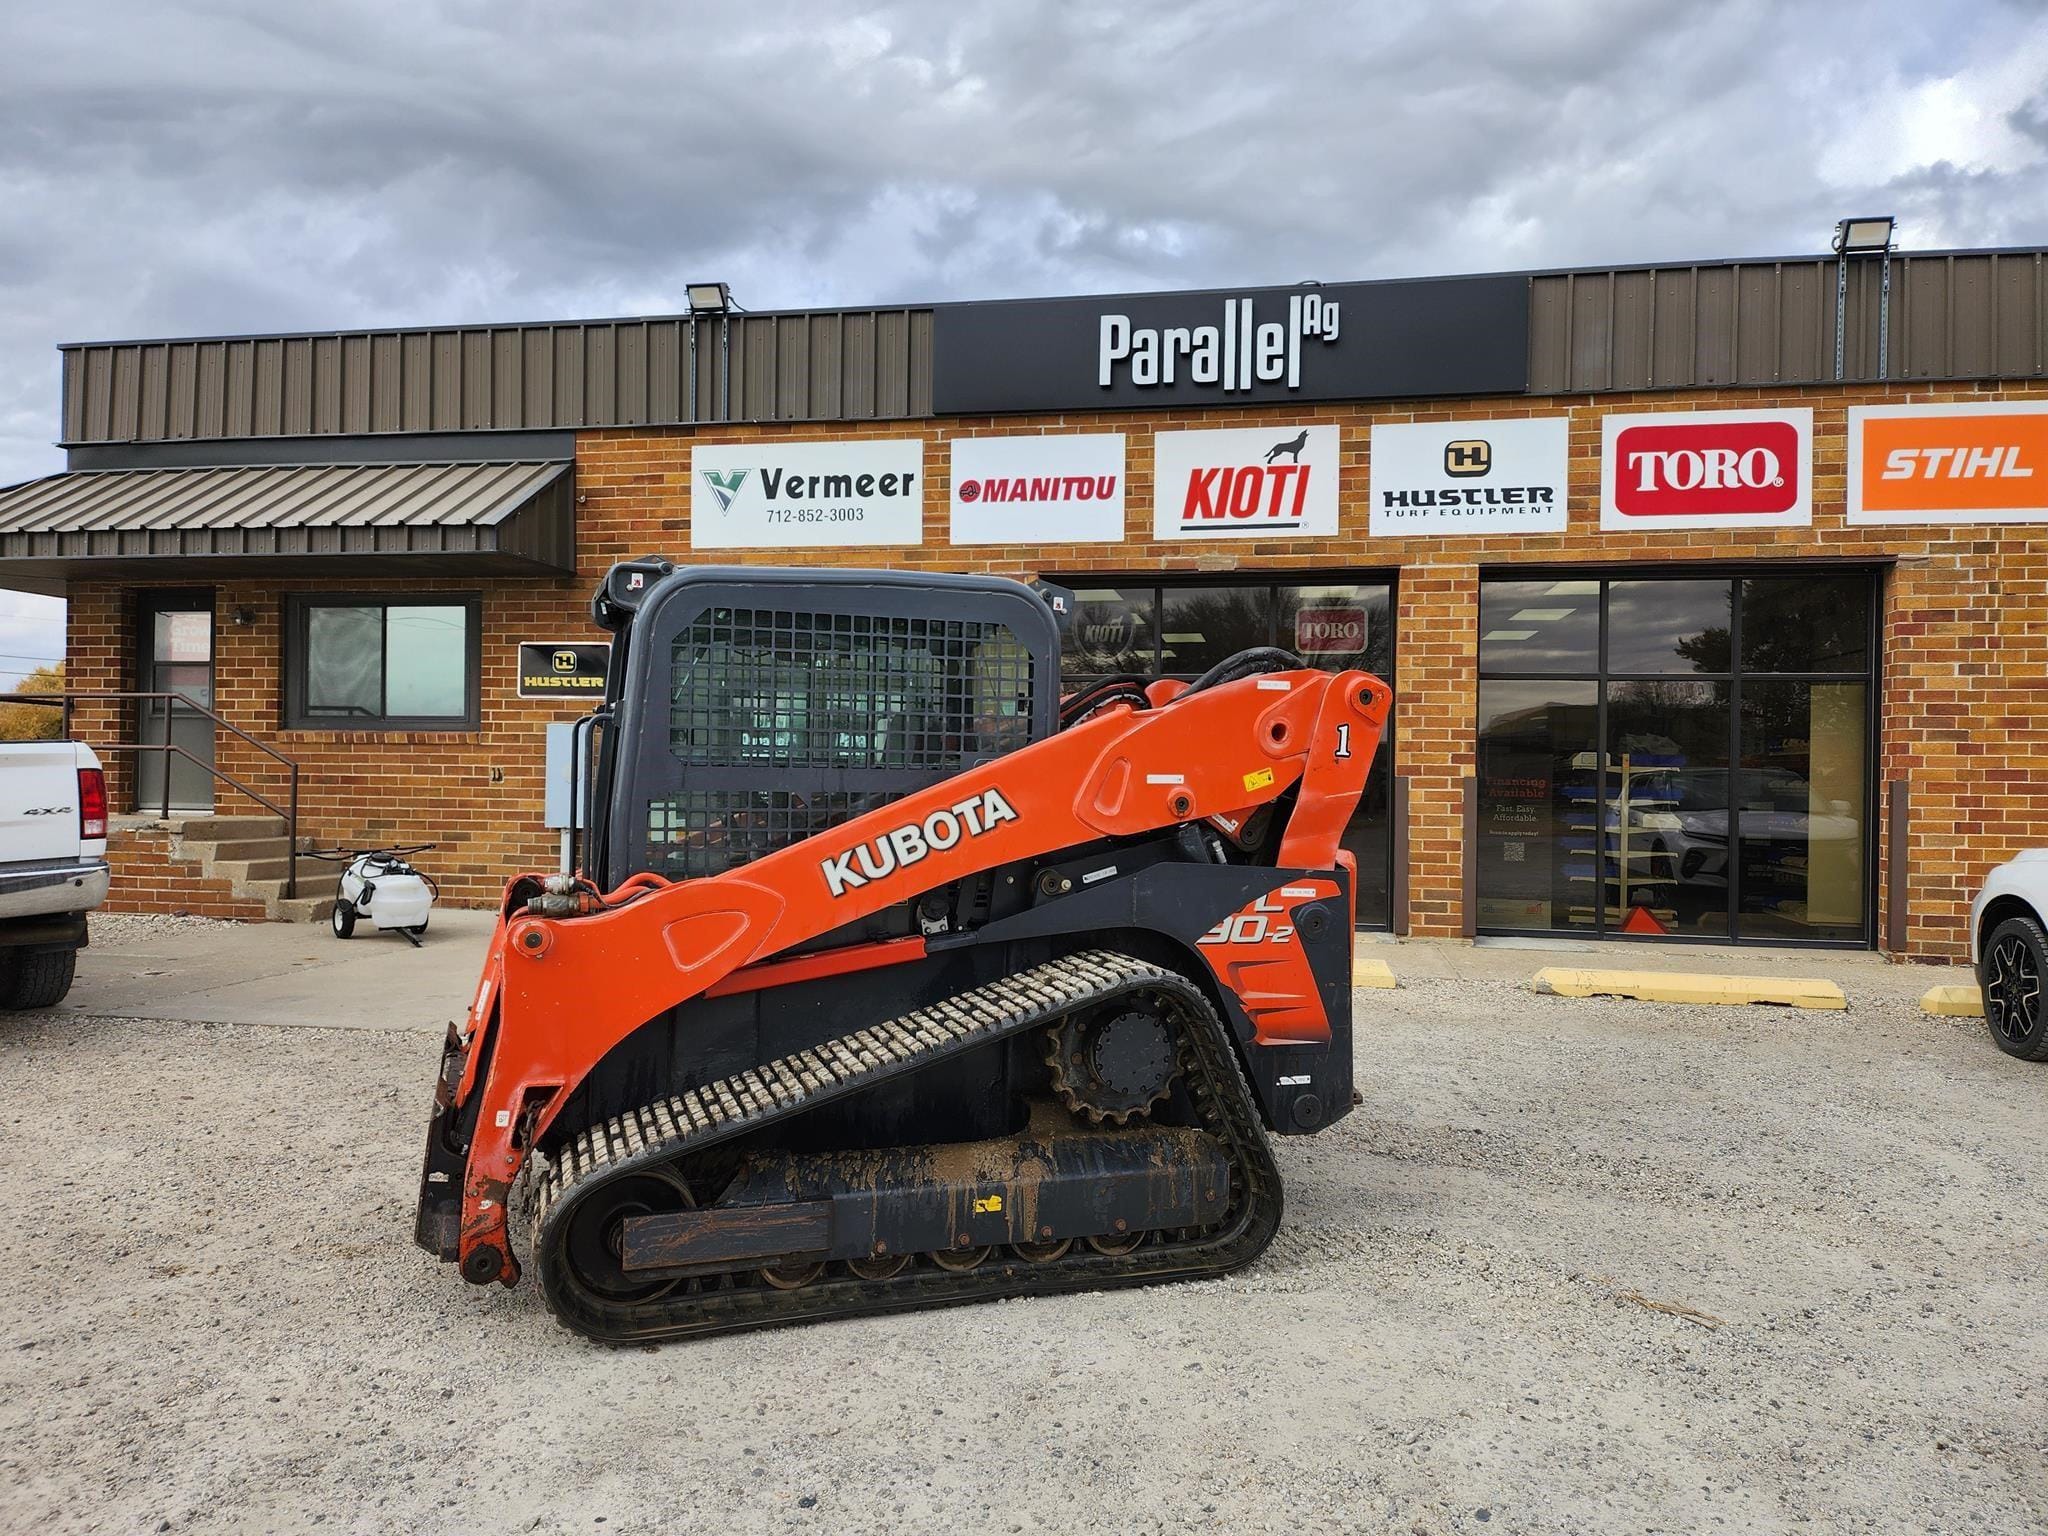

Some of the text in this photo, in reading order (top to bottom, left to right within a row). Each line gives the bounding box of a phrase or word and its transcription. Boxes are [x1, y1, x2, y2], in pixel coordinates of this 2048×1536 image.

[1099, 294, 1340, 391] Parallel Ag
[1881, 446, 2034, 480] STIHL
[760, 467, 915, 500] Vermeer
[982, 476, 1117, 503] MANITOU
[1182, 465, 1311, 519] KIOTI
[1383, 486, 1554, 508] HUSTLER
[767, 508, 864, 523] 712-852-3003
[1384, 506, 1554, 518] TURF EQUIPMENT
[1084, 624, 1124, 642] KIOTI
[1302, 621, 1359, 639] TORO
[523, 676, 604, 688] HUSTLER
[1335, 724, 1351, 757] 1
[1486, 777, 1546, 788] Financing
[1489, 788, 1545, 798] Available
[820, 788, 1019, 897] KUBOTA
